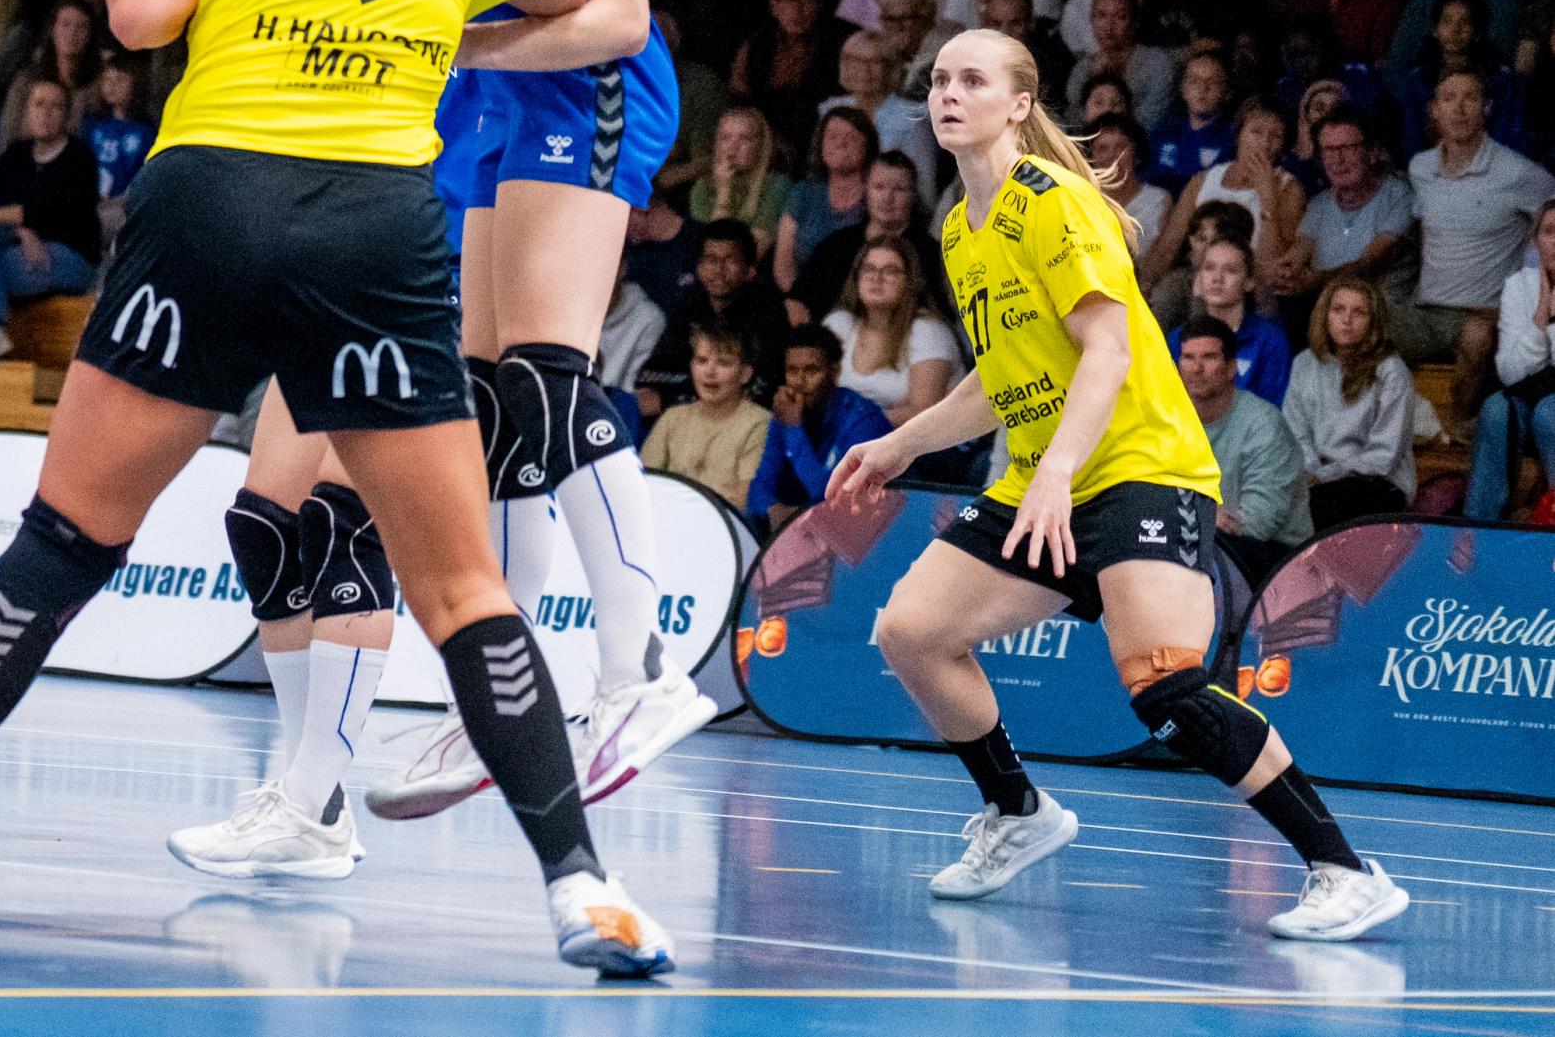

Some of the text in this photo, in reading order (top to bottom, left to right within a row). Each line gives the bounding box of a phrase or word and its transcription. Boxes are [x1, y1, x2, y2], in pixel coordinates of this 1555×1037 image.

[967, 287, 991, 357] 17
[1006, 308, 1038, 328] Lyse
[989, 371, 1055, 411] galand
[1004, 388, 1067, 429] areban
